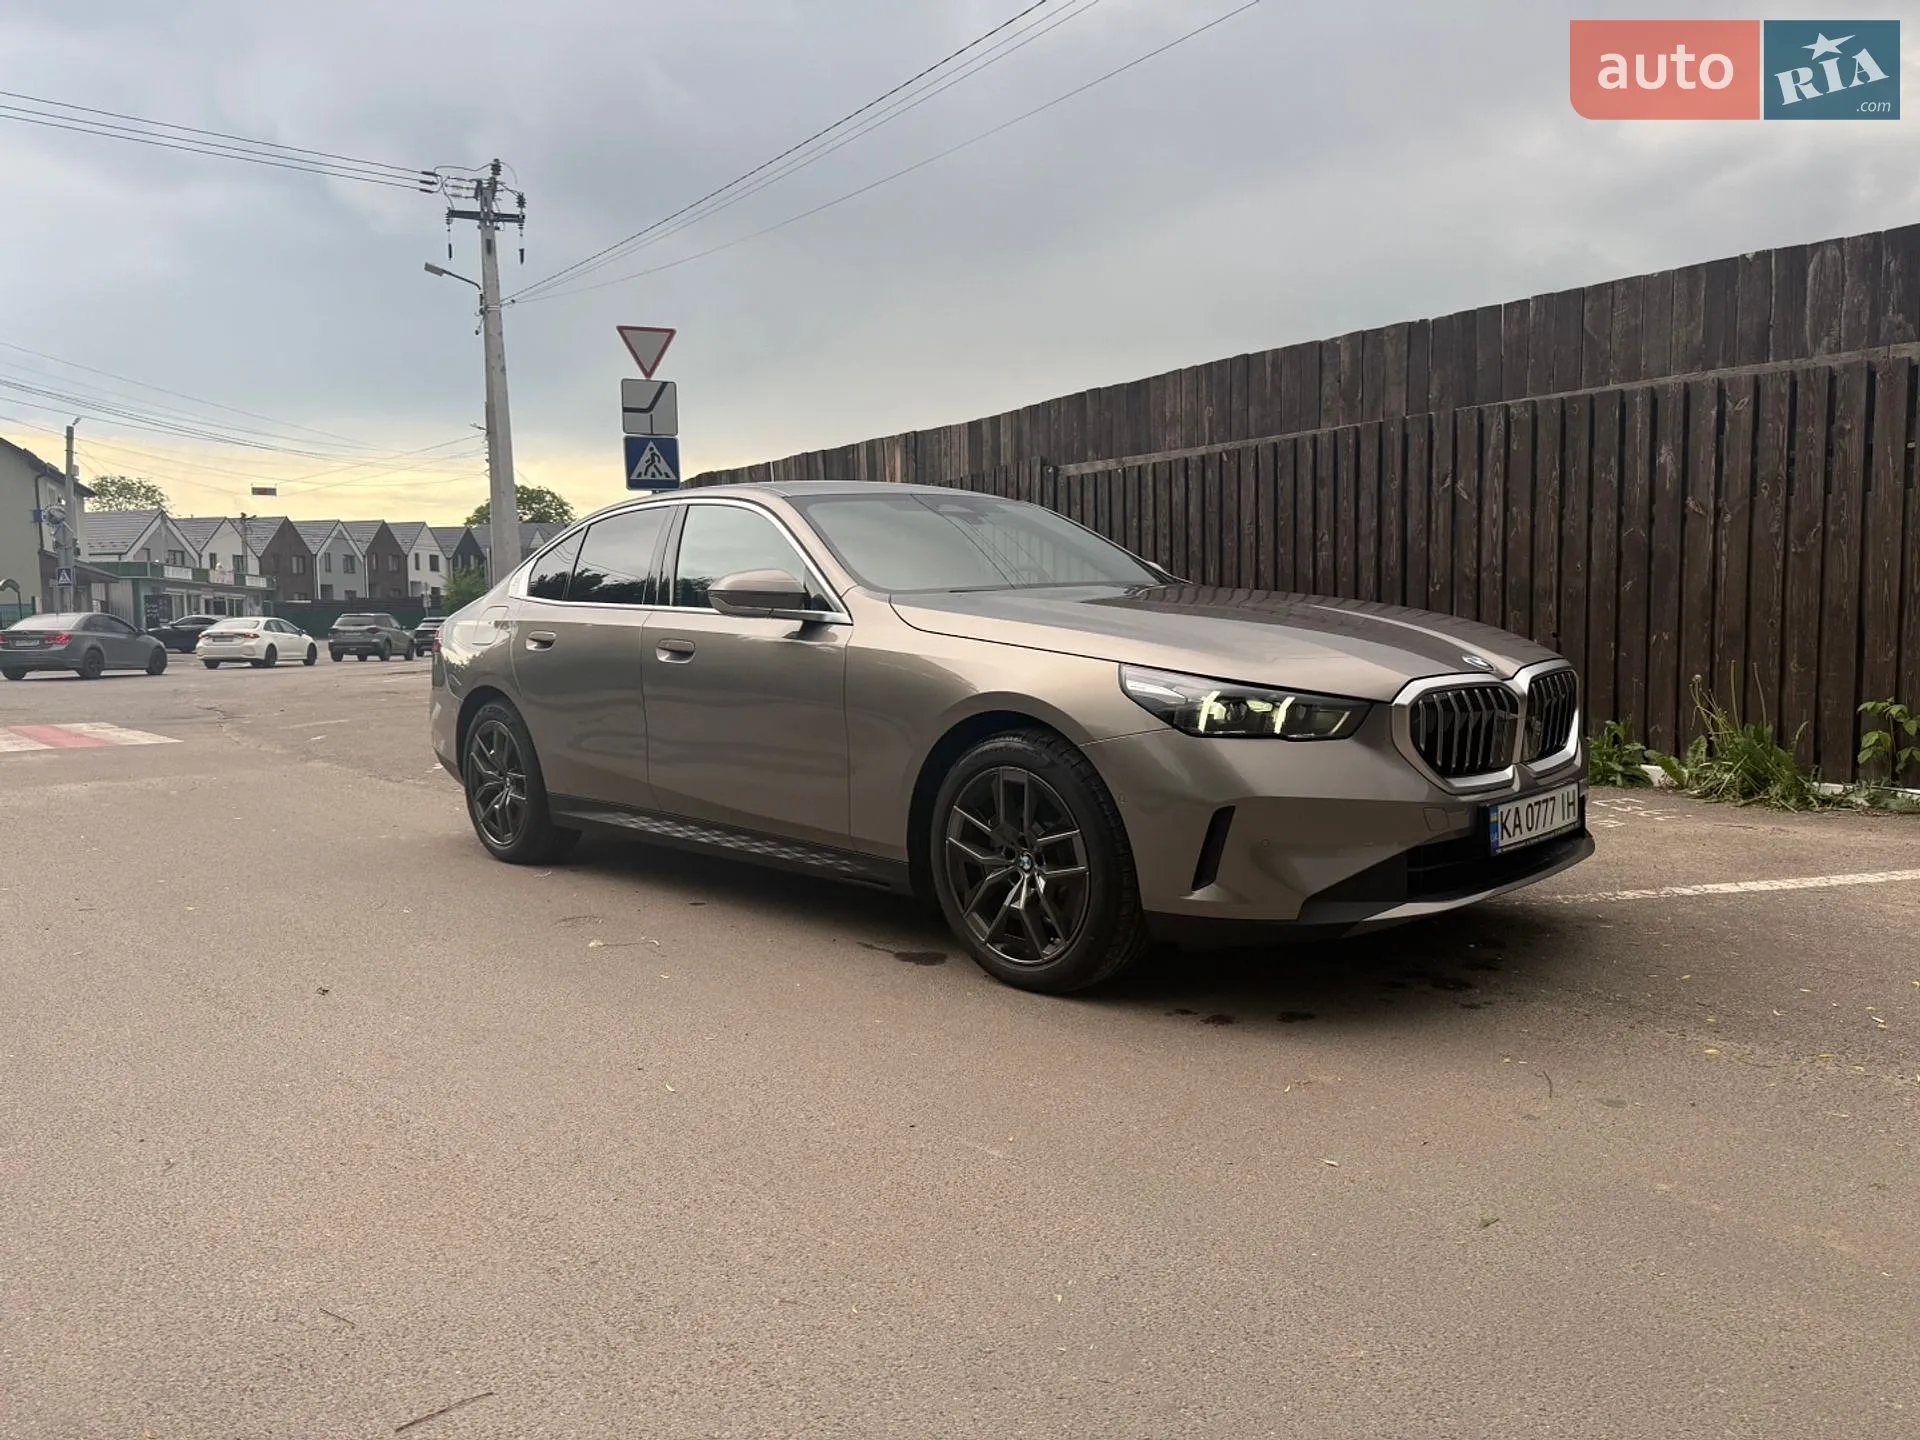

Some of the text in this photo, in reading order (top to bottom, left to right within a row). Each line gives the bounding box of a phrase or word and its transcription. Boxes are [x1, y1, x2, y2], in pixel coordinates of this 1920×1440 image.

[1500, 807, 1523, 841] KA
[1525, 796, 1556, 832] 0777
[1561, 789, 1576, 821] IH
